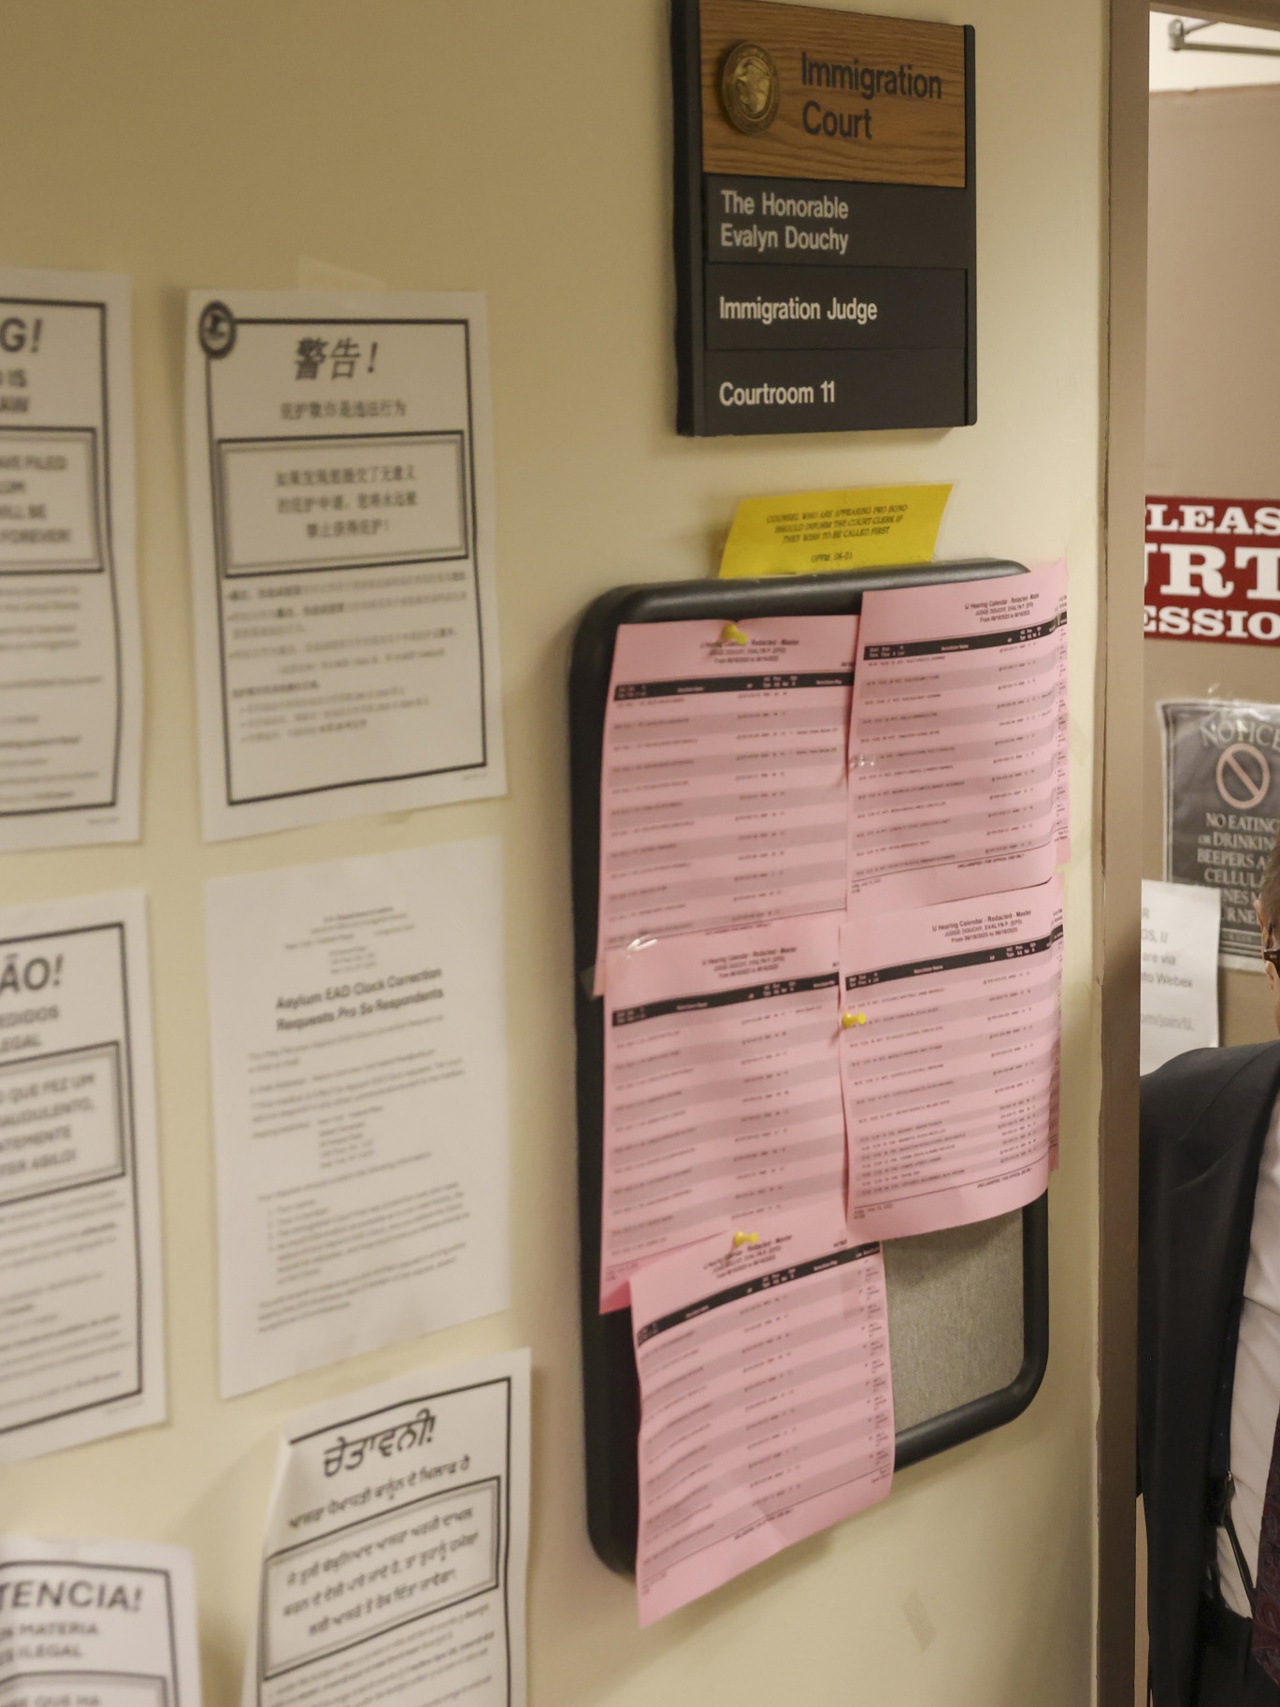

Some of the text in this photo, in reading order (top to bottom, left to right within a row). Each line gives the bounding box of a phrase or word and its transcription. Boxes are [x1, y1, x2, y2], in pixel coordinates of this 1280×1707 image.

[802, 52, 942, 100] Immigration
[802, 100, 872, 139] Court
[721, 190, 849, 219] The Honorable
[721, 223, 849, 255] Evalyn Douchy
[720, 296, 877, 324] Immigration Judge
[719, 381, 835, 406] Courtroom 11
[1206, 812, 1280, 833] NO EATING
[1213, 832, 1278, 851] DRINKIN
[1197, 847, 1254, 868] BEEPERS
[275, 992, 322, 1011] Asylum
[325, 984, 352, 1001] EAD
[387, 968, 442, 988] Correction
[1156, 972, 1193, 988] Webex
[276, 1012, 335, 1031] Requests
[338, 1006, 357, 1020] Pro
[375, 988, 444, 1010] Respondents
